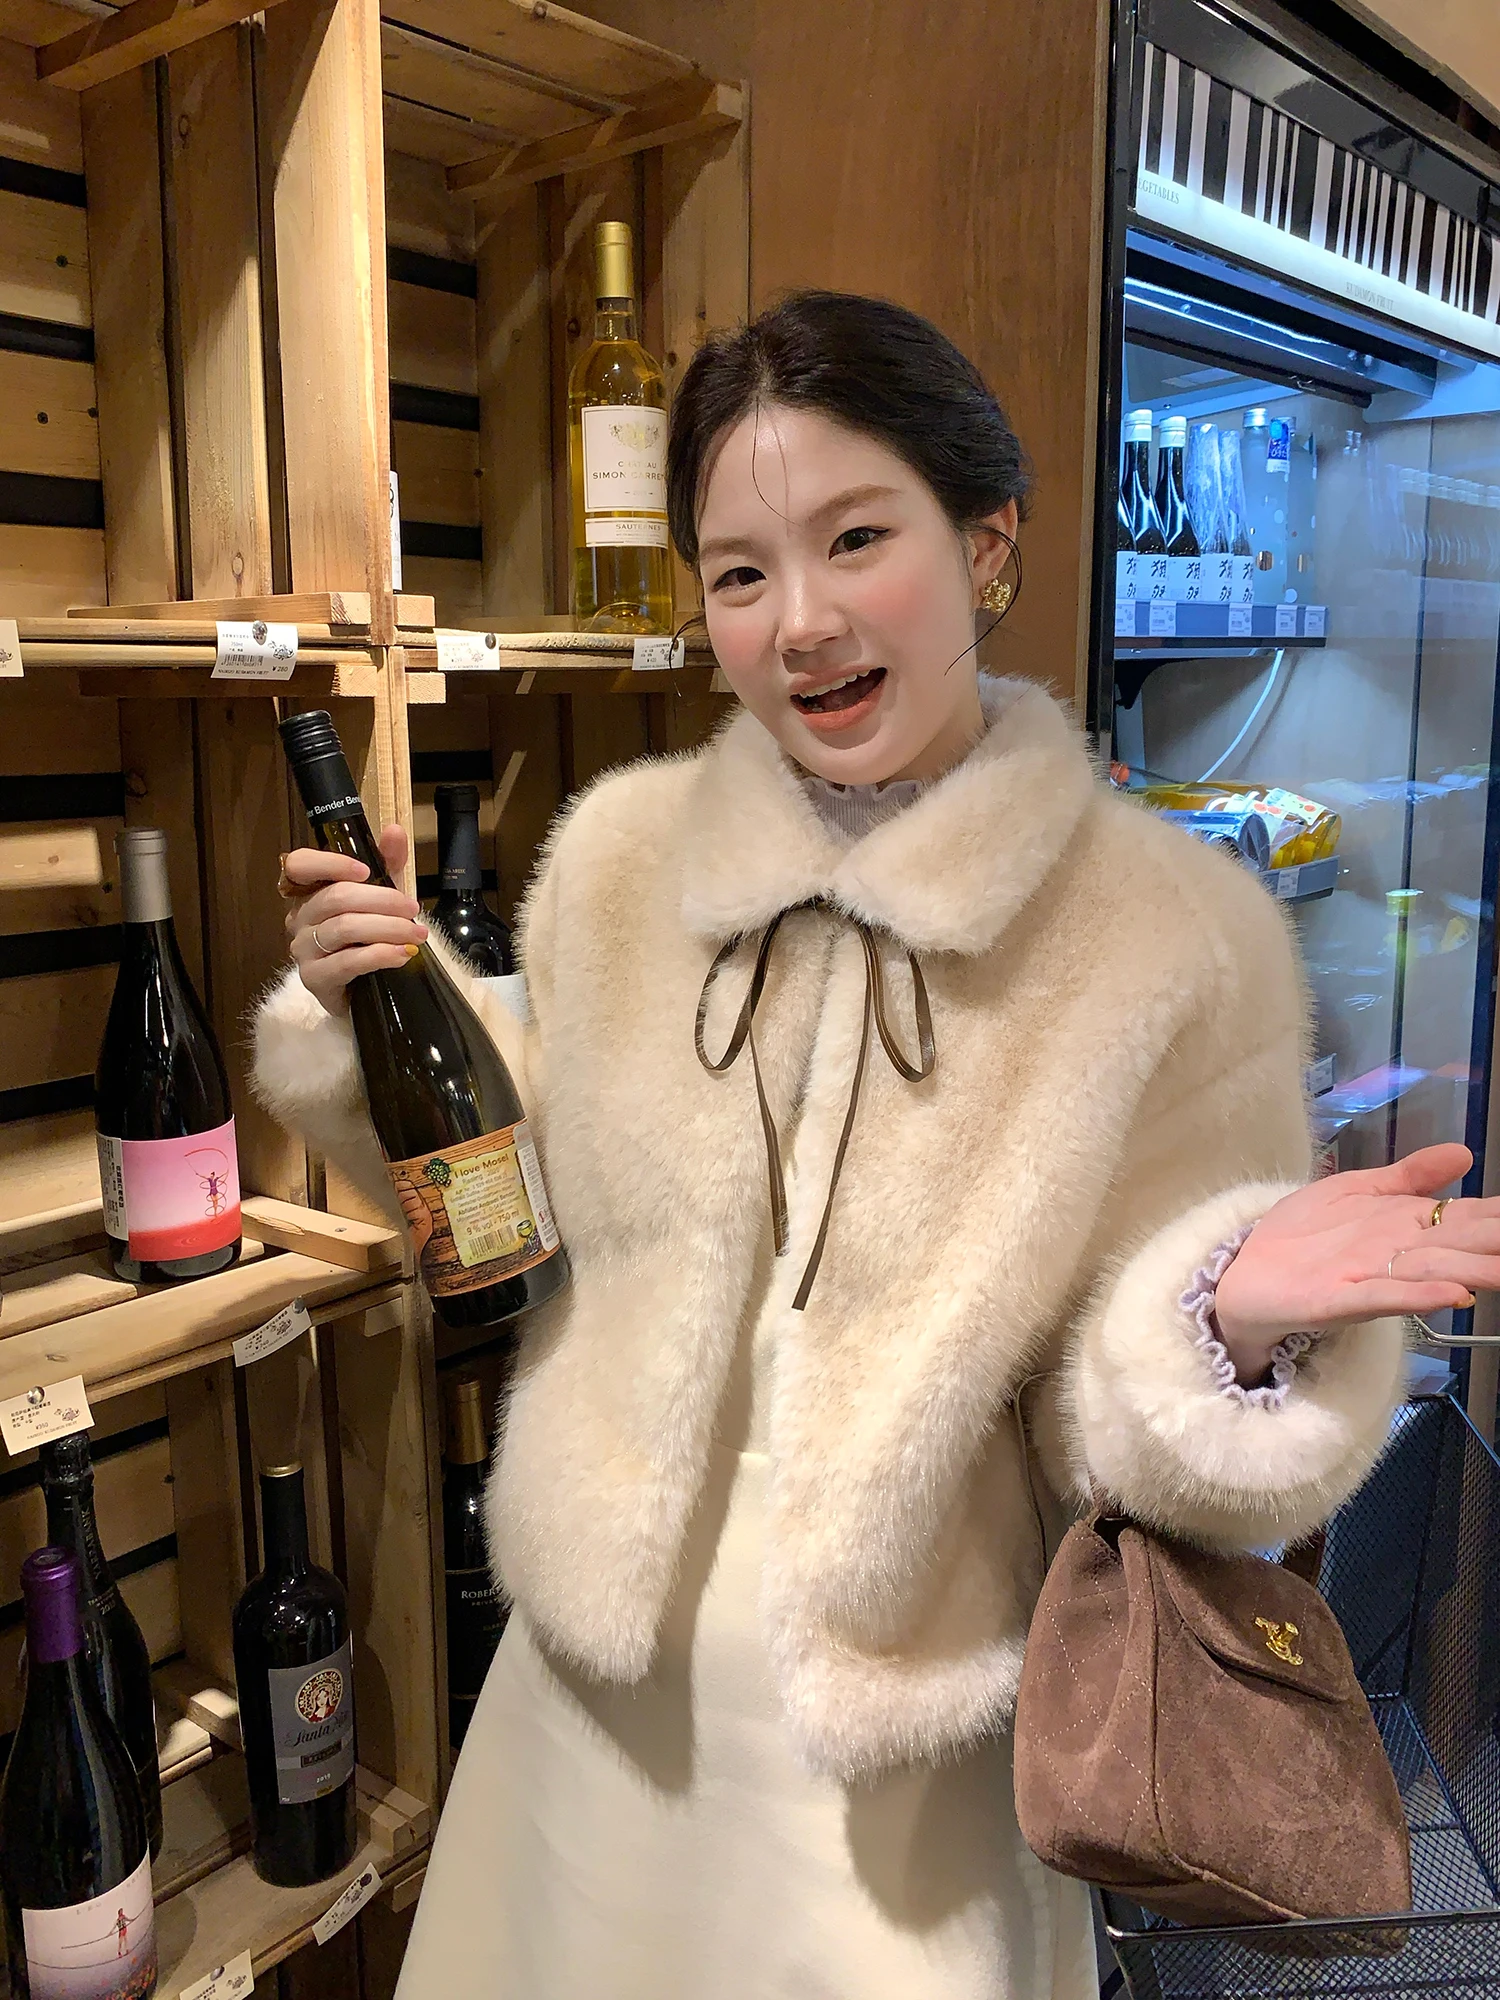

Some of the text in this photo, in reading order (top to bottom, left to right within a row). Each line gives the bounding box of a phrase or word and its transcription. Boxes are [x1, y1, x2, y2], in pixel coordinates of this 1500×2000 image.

[592, 470, 627, 480] SIMON
[313, 799, 346, 815] Bender
[453, 1153, 510, 1179] I love Mosel
[497, 1212, 511, 1224] 750
